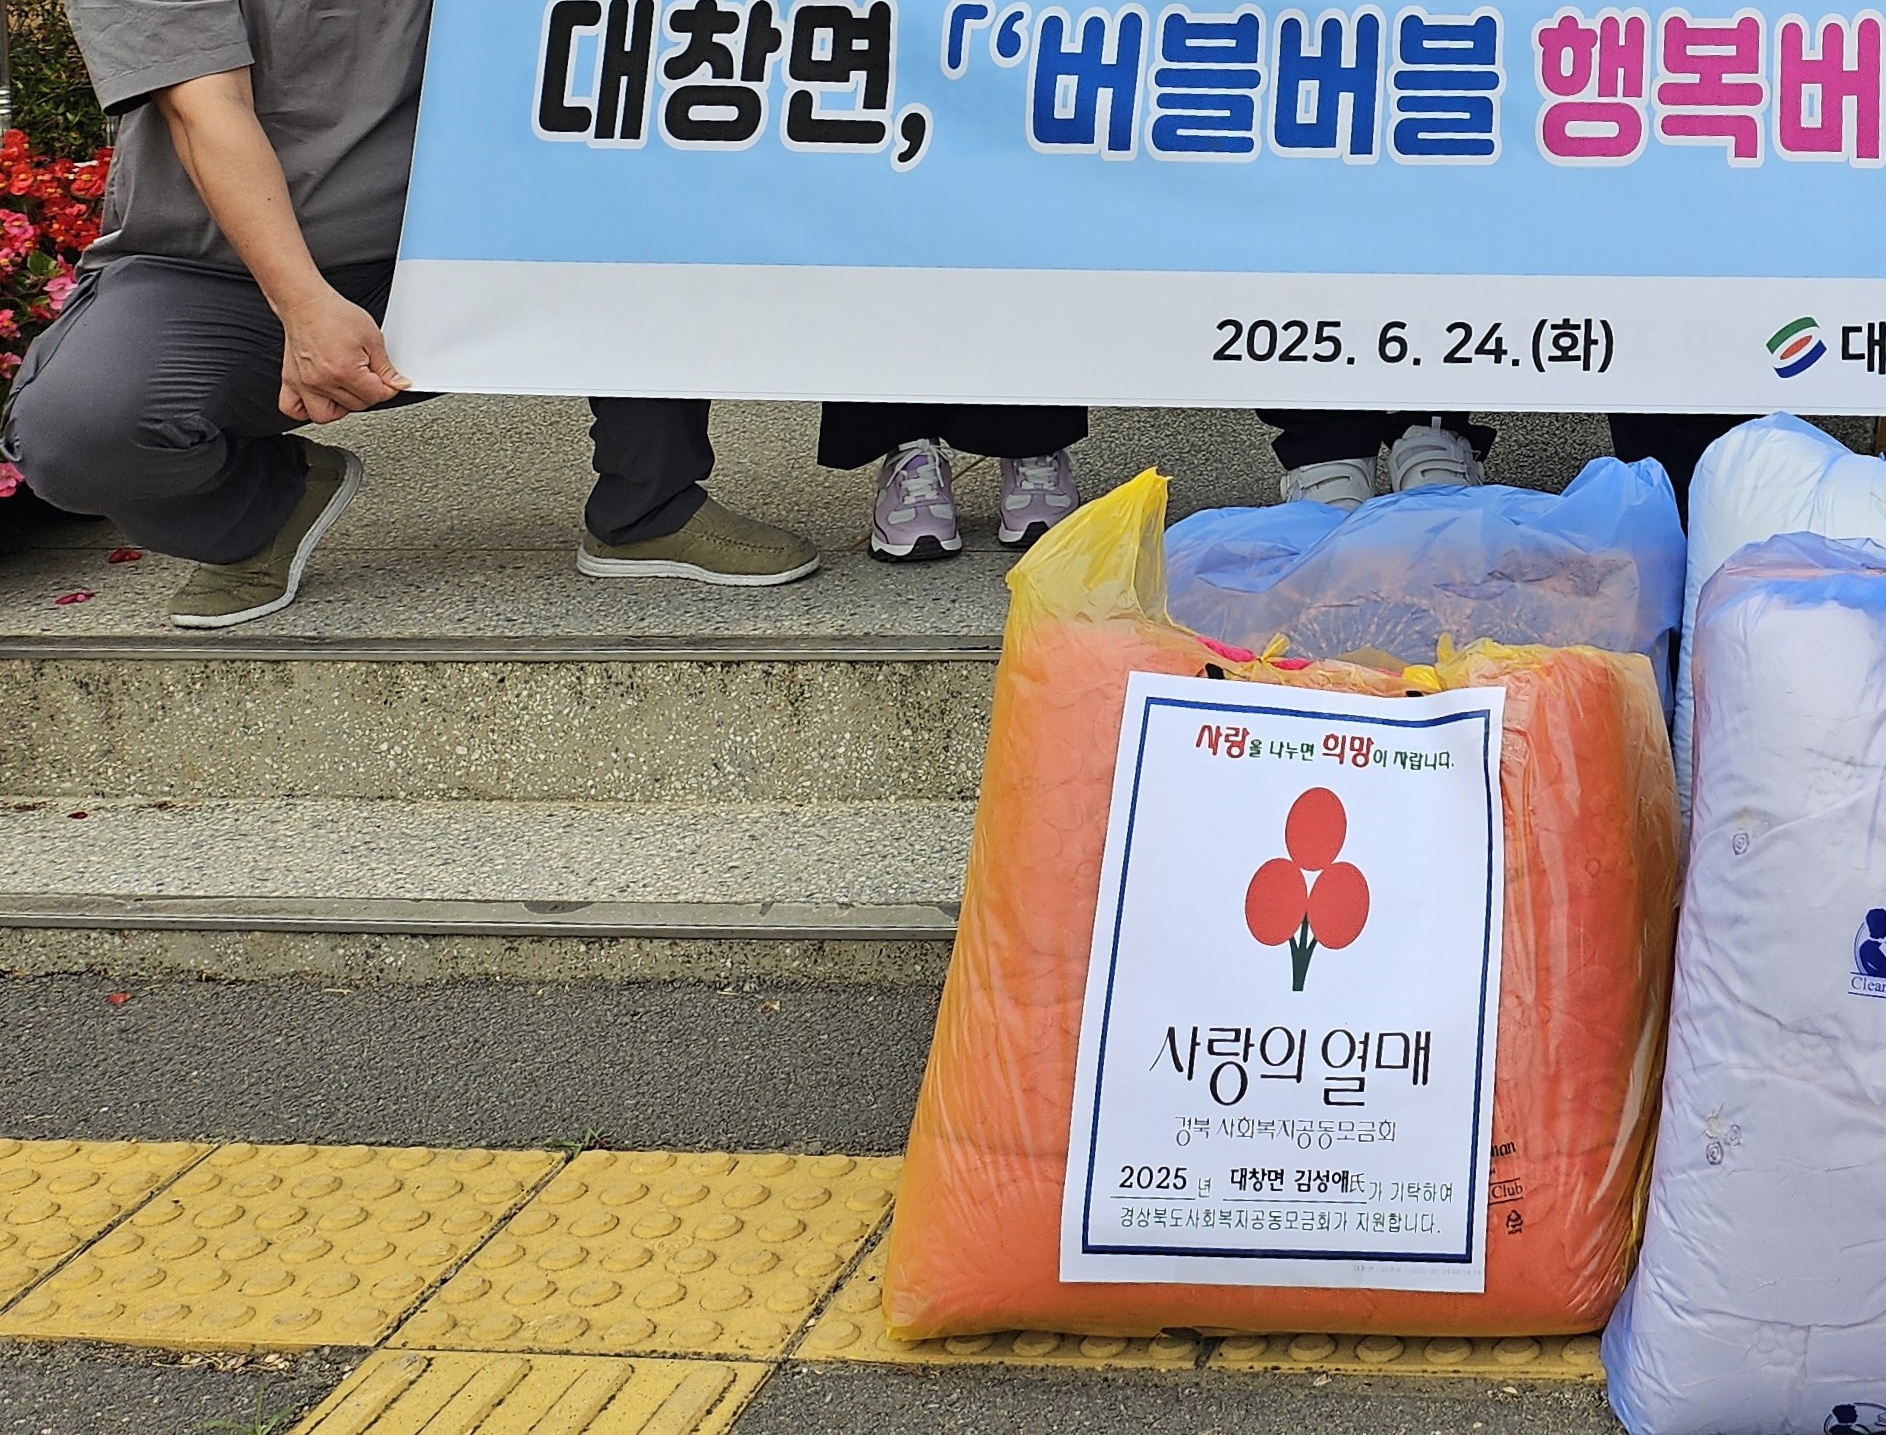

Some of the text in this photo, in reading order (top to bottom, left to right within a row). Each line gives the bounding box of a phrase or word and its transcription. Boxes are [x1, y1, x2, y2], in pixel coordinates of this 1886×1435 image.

[1212, 317, 1615, 373] 2025. 6. 24.(화)
[1196, 723, 1455, 771] 사랑을 나누면 희망이 자랍니다.
[1149, 1025, 1432, 1108] 사랑의 열매
[1174, 1115, 1397, 1150] 경북 사회복지공동모금회
[1119, 1165, 1189, 1191] 2025
[1197, 1176, 1212, 1199] 년
[1230, 1169, 1286, 1194] 대창면
[1390, 1180, 1454, 1205] 기탁하여
[1491, 1181, 1524, 1200] Club
[1120, 1206, 1442, 1235] 경상북도사회복지공동모금회가 지원합니다.
